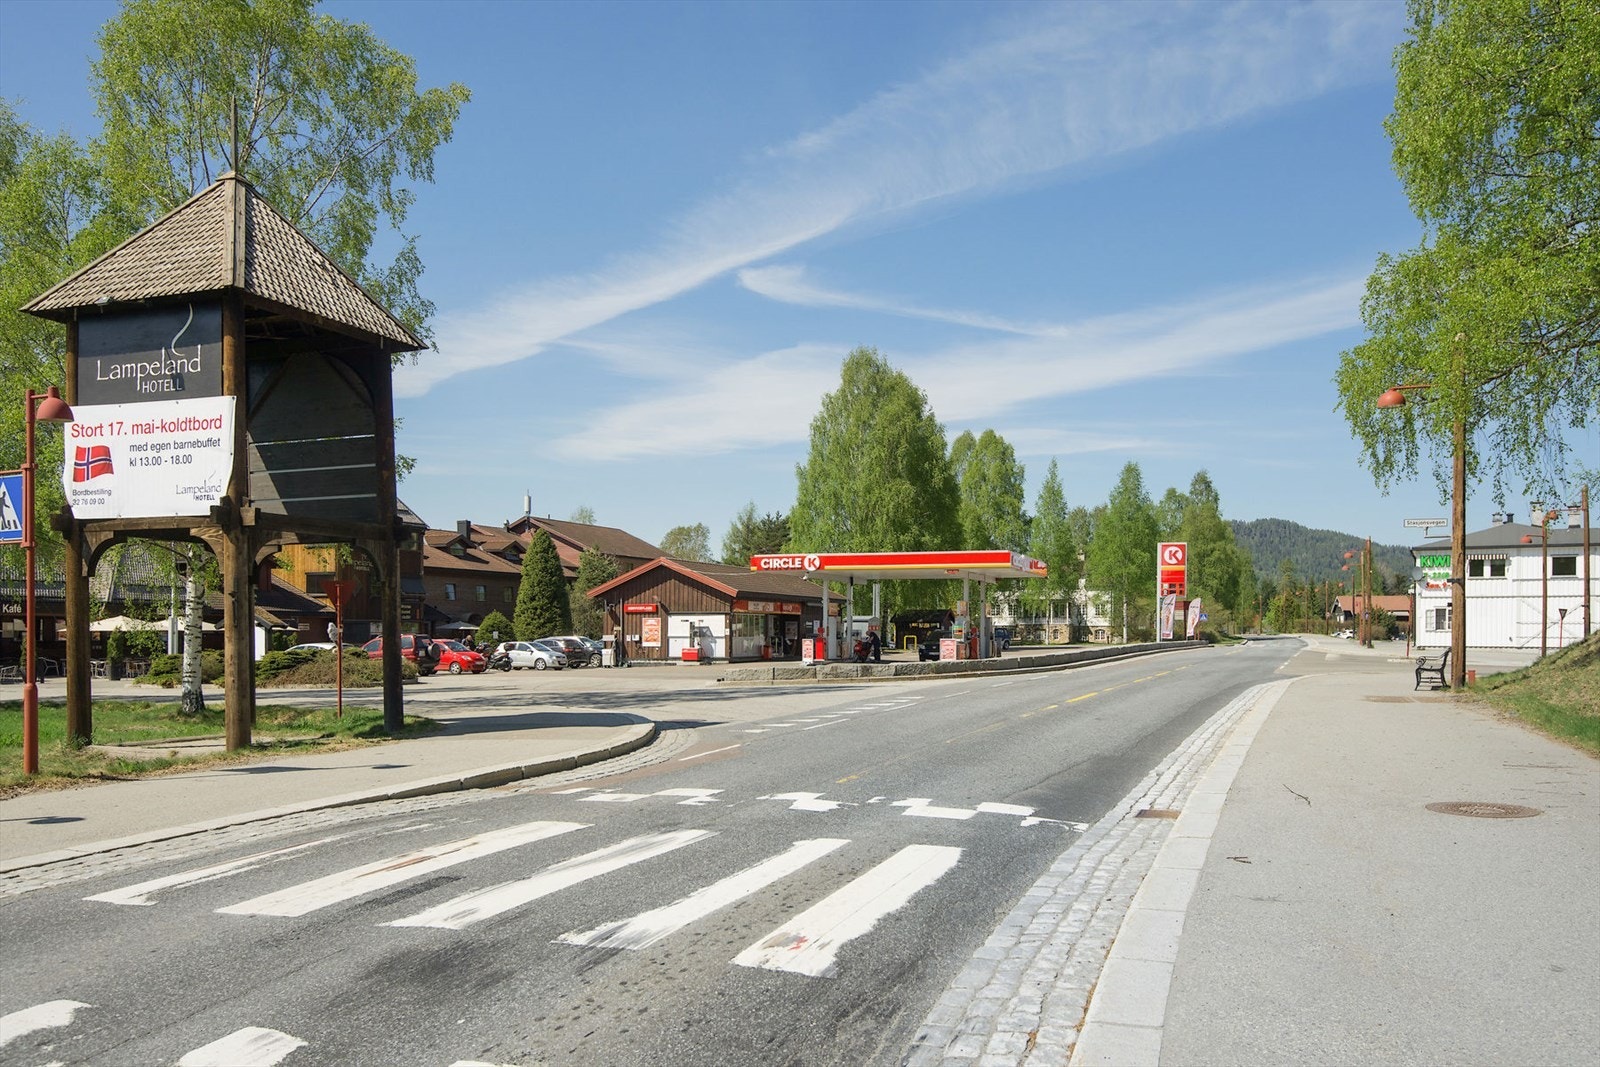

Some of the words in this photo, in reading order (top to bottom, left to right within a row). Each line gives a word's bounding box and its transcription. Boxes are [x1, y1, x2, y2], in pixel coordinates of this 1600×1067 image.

[96, 345, 201, 391] Lampeland
[142, 378, 182, 394] HOTELL
[71, 422, 104, 438] Stort
[108, 421, 127, 436] 17.
[132, 415, 222, 435] mai-koldtbord
[129, 439, 148, 453] med
[150, 440, 171, 454] egen
[173, 438, 221, 451] barnebuffet
[129, 456, 137, 467] kl
[139, 455, 162, 467] 13.00
[170, 454, 192, 466] 18.00
[72, 488, 112, 496] Bordbestilling
[176, 479, 222, 500] Lampeland
[760, 557, 802, 569] CIRCLE
[1420, 555, 1451, 568] KIWI
[2, 603, 22, 614] Kafé
